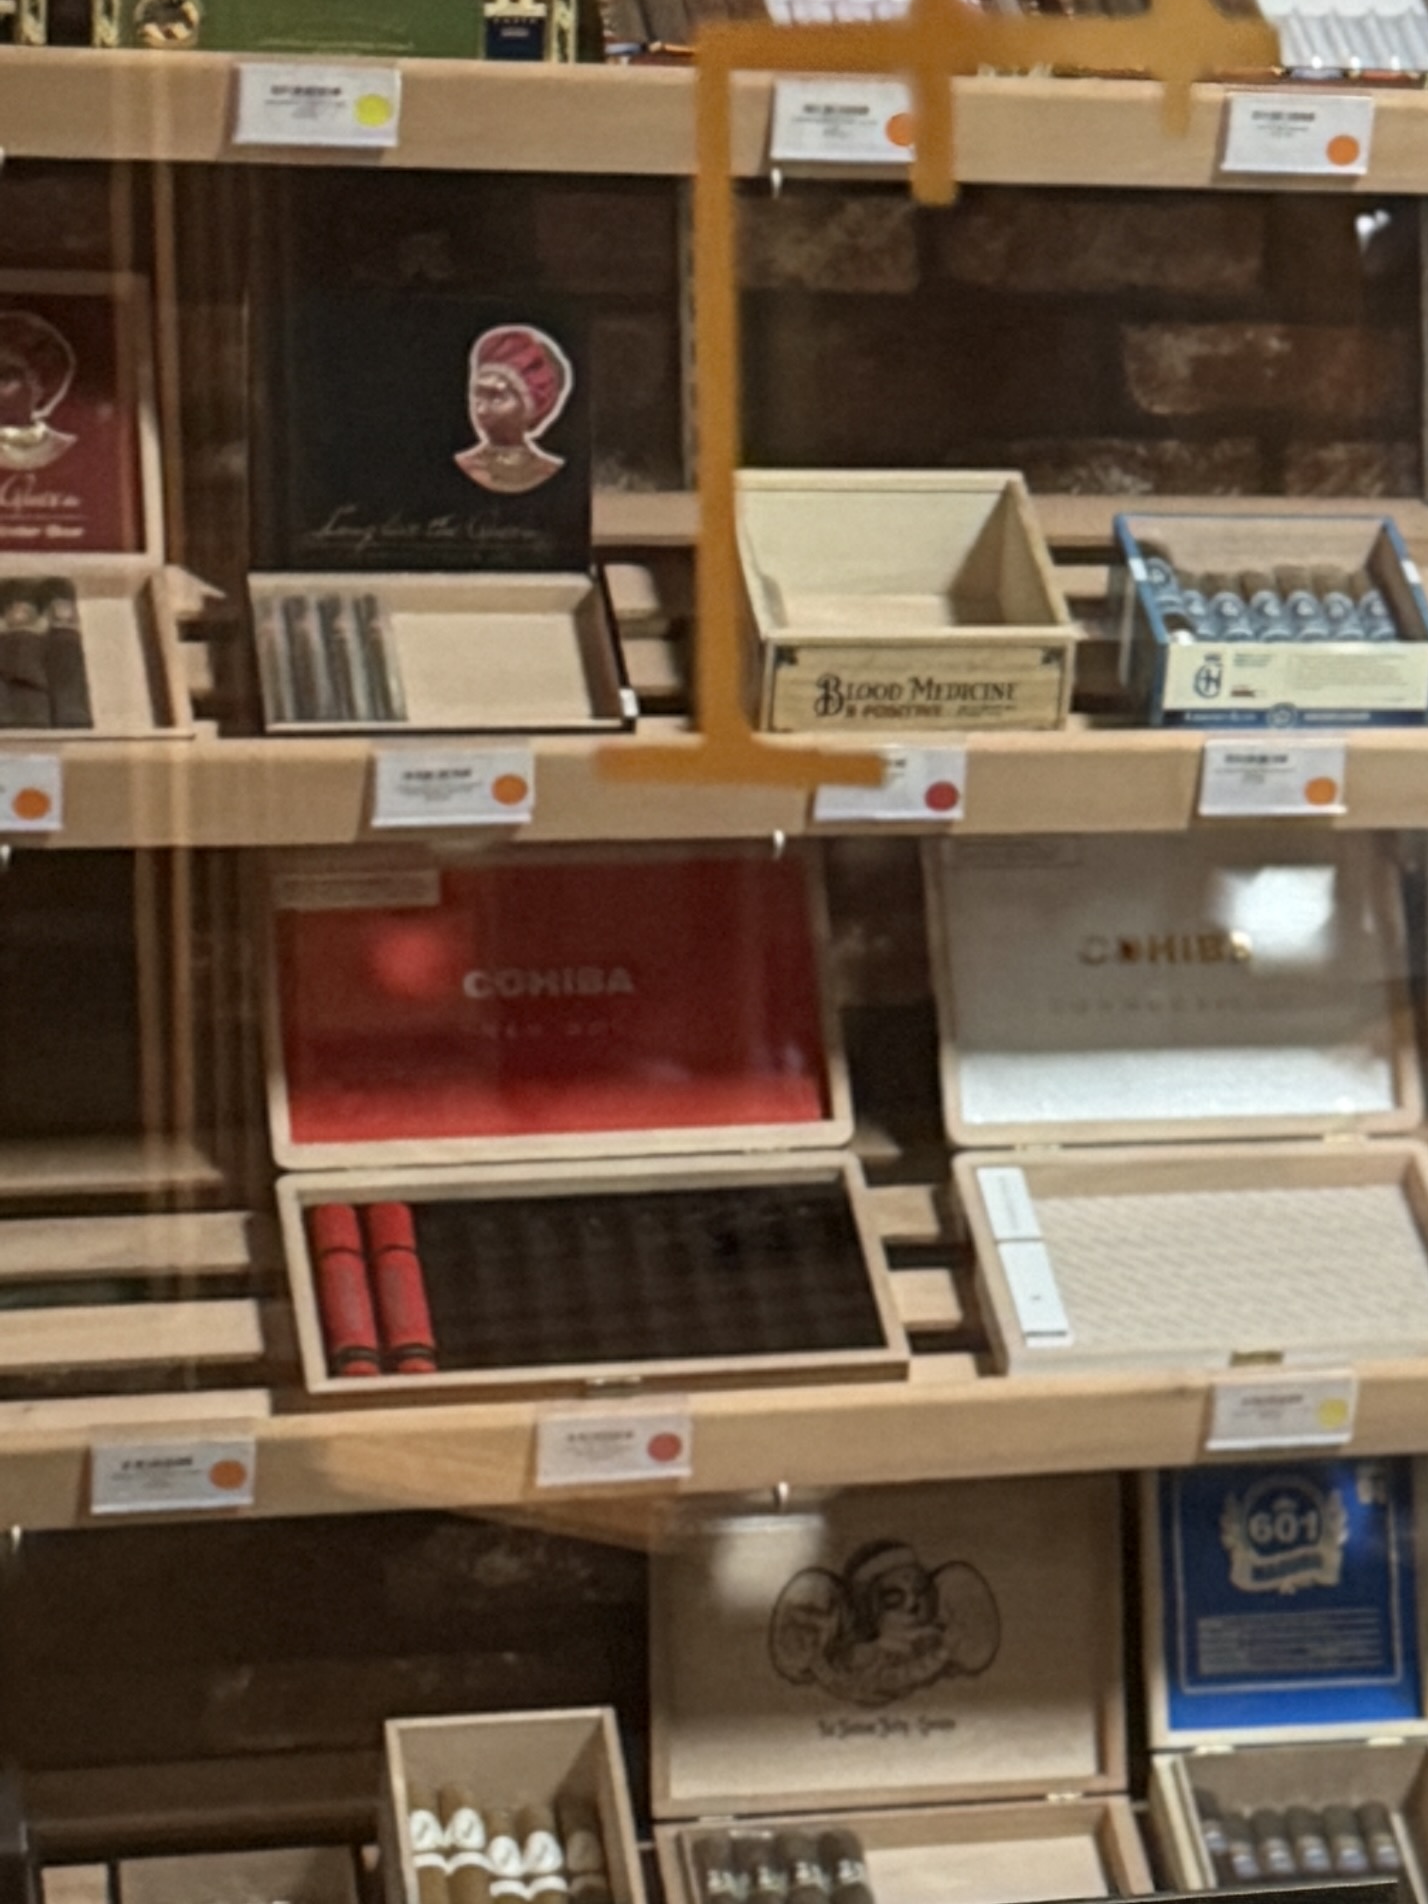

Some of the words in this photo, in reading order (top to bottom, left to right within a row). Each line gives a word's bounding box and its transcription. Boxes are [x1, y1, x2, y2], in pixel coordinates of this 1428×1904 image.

[813, 672, 904, 718] BLOOD
[909, 675, 1019, 703] MEDICINE
[462, 965, 636, 1000] COHIBA
[1247, 1508, 1322, 1545] 601
